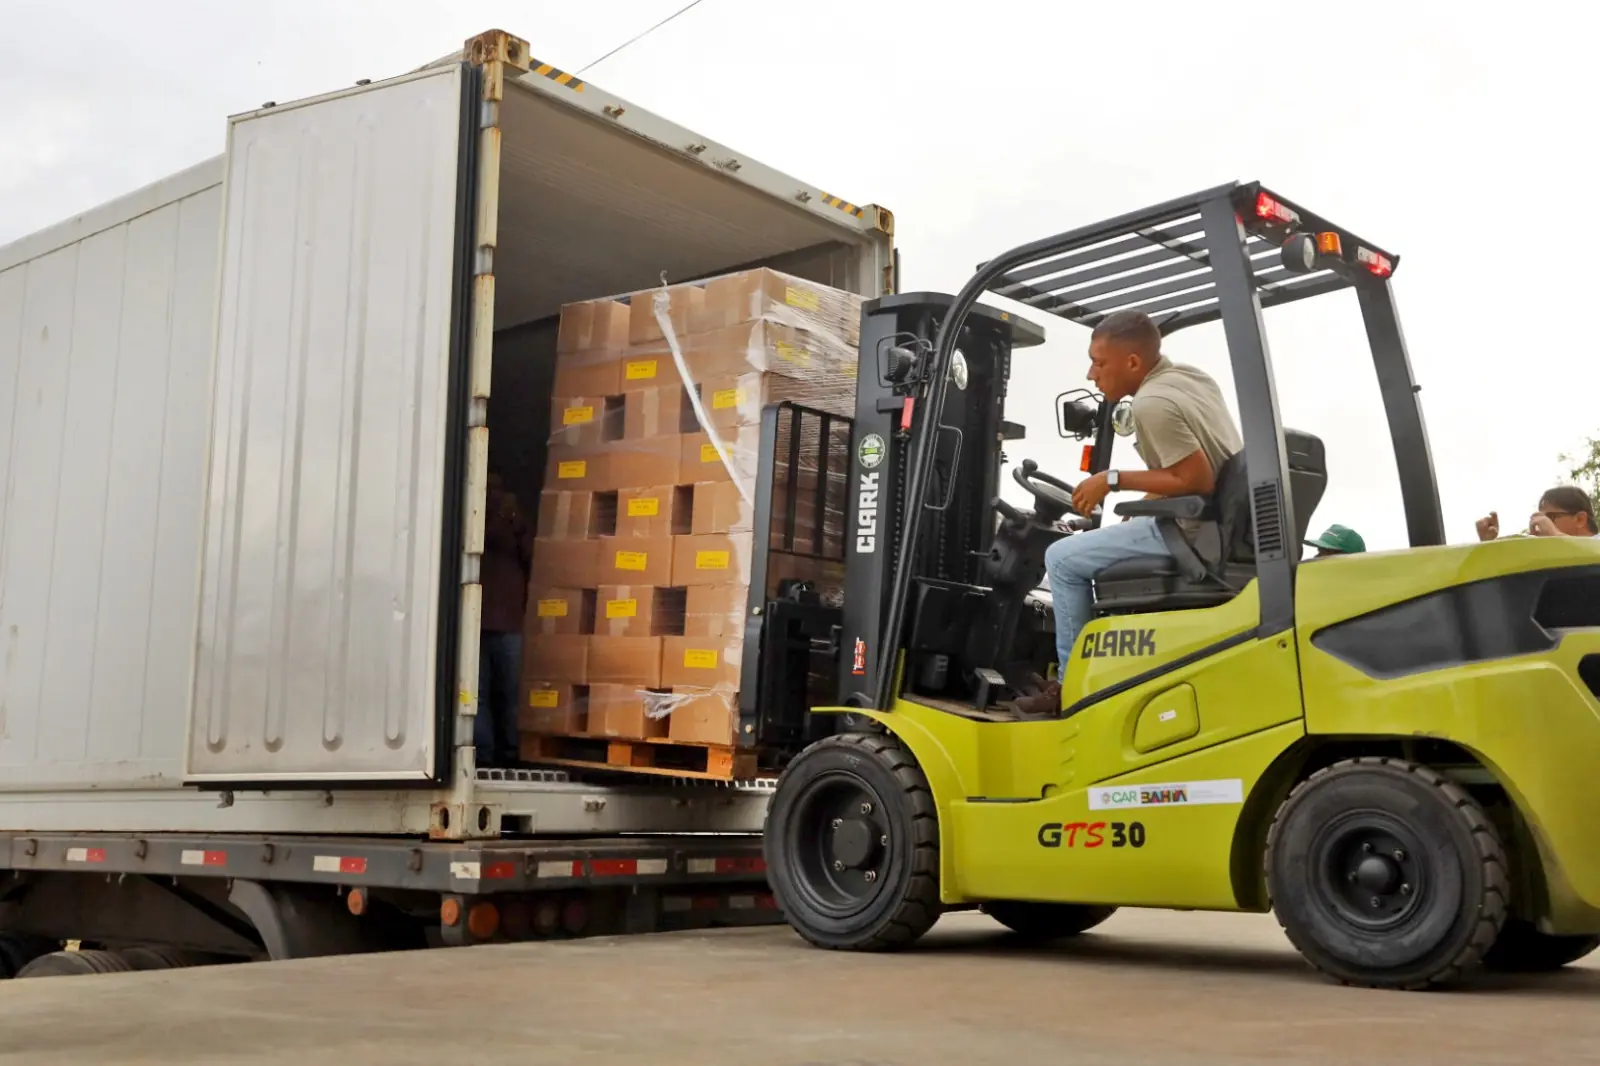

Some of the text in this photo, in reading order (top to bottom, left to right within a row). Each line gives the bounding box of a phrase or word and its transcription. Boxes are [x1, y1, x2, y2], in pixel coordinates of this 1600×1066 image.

[856, 472, 880, 554] CLARK
[1081, 628, 1156, 659] CLARK
[1111, 789, 1137, 804] CAR
